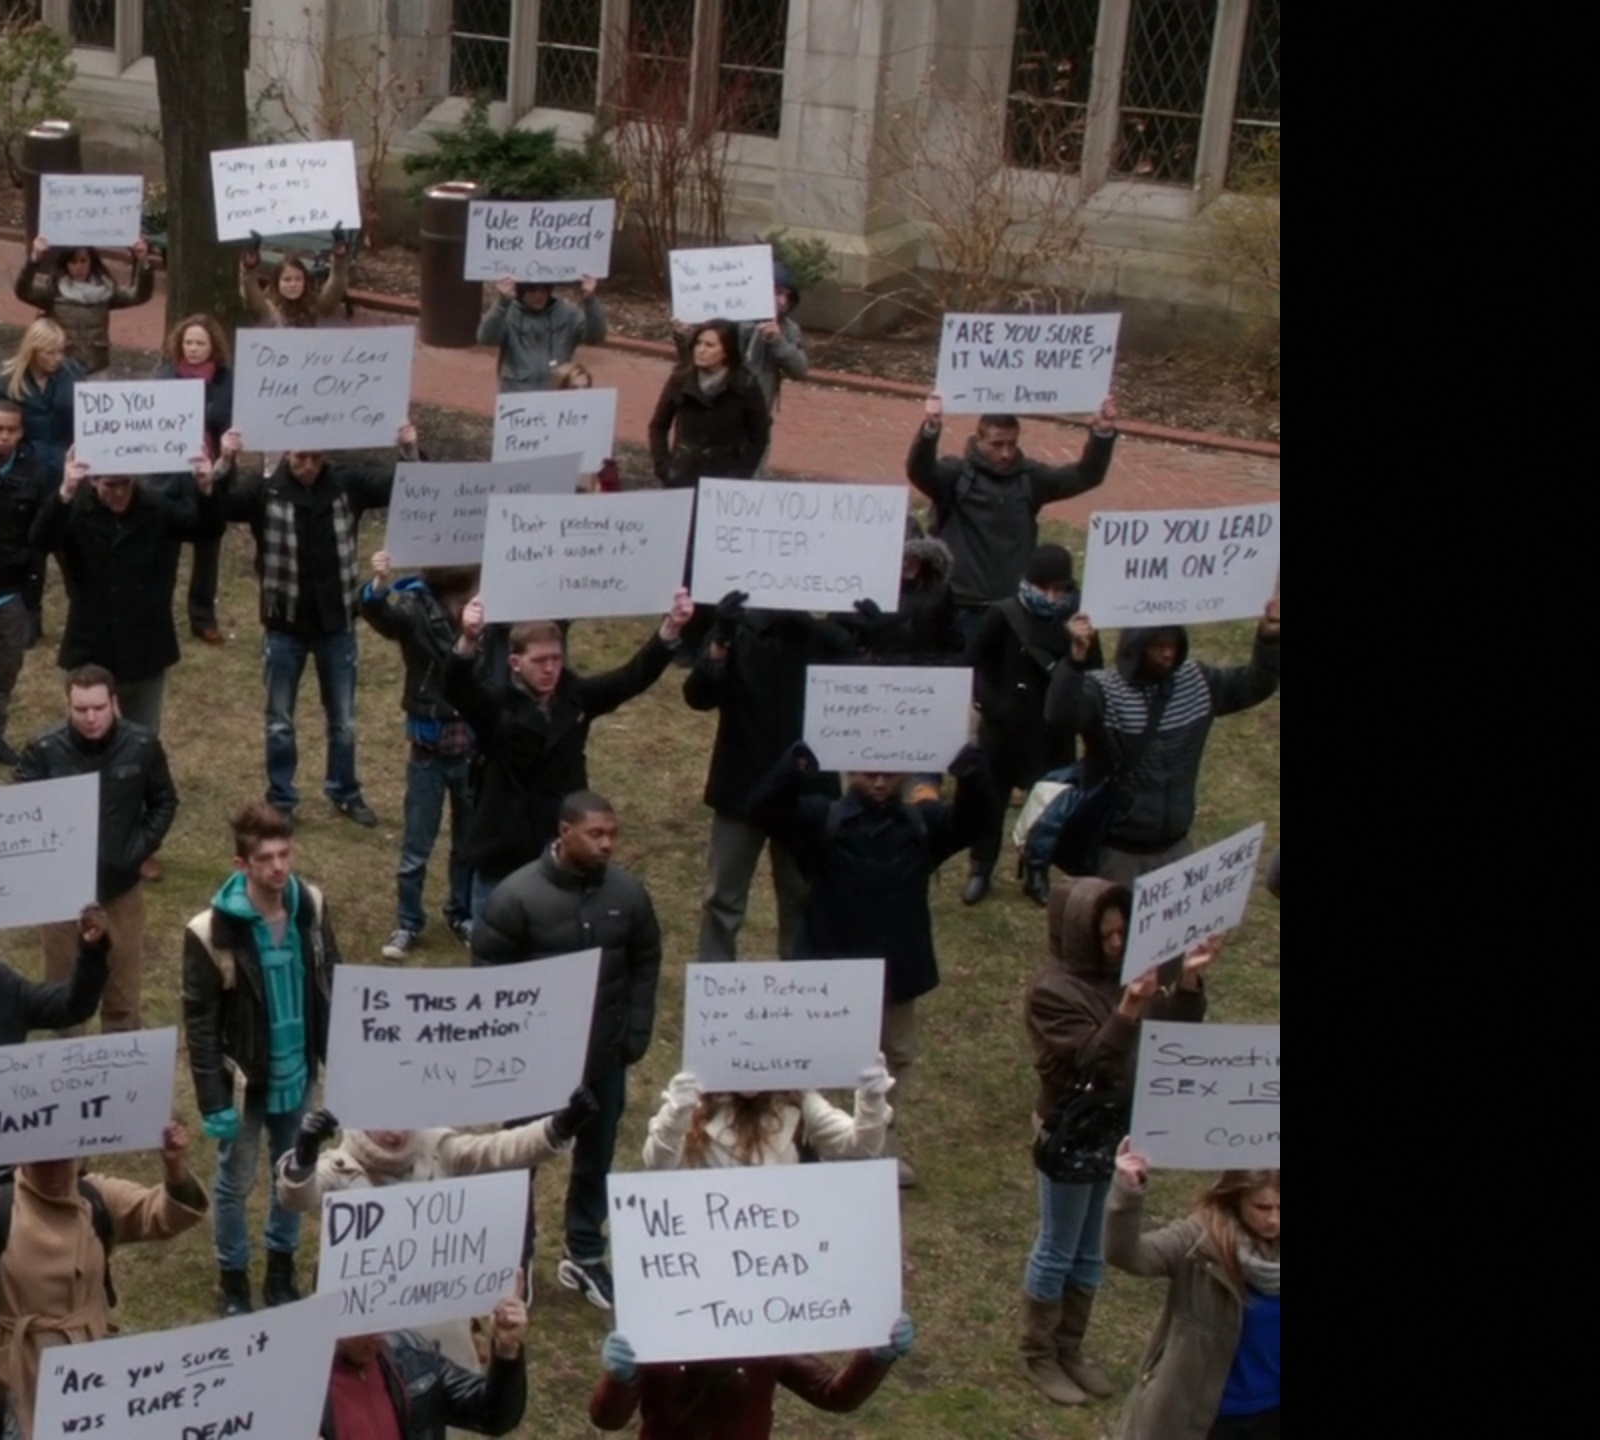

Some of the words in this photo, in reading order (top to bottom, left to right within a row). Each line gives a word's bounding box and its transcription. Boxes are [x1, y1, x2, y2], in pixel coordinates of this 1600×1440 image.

[529, 206, 594, 233] Raped
[535, 230, 604, 250] Dead"
[1004, 322, 1040, 343] YOU
[1045, 324, 1095, 344] SURE
[952, 351, 971, 369] IT
[980, 349, 1023, 369] WAS
[120, 392, 155, 410] YOU
[1015, 385, 1058, 402] Dean
[82, 420, 120, 436] LEAD
[125, 418, 153, 431] HIM
[776, 491, 820, 521] YOU
[831, 492, 898, 524] KNOW
[560, 519, 611, 537] pretend
[615, 519, 644, 534] you
[1163, 519, 1211, 544] YOU
[1219, 513, 1273, 540] LEAD
[505, 545, 554, 562] didn't
[563, 546, 604, 558] want
[1125, 556, 1169, 580] HIM
[1181, 544, 1258, 578] ON?"
[763, 974, 828, 996] Pretend
[405, 993, 457, 1012] THIS
[466, 993, 482, 1010] A
[495, 987, 541, 1009] PLOY
[700, 1010, 728, 1027] you
[807, 1006, 851, 1019] want
[61, 1037, 147, 1066] Pretend
[731, 1057, 812, 1072] HALLMATE
[473, 1056, 526, 1081] DAD
[1148, 1077, 1219, 1097] SEX
[1248, 1081, 1280, 1098] IS
[405, 1188, 465, 1230] YOU
[705, 1192, 800, 1231] RAPED
[340, 1238, 417, 1280] LEAD
[432, 1226, 487, 1267] HIM
[640, 1252, 700, 1279] HER
[474, 1268, 514, 1295] COP
[700, 1300, 753, 1328] TAU
[763, 1296, 852, 1323] OMEGA
[127, 1362, 165, 1388] you
[181, 1347, 231, 1369] sure
[247, 1331, 269, 1356] it
[127, 1378, 226, 1418] RAPE?"
[182, 1411, 254, 1440] DEAN
